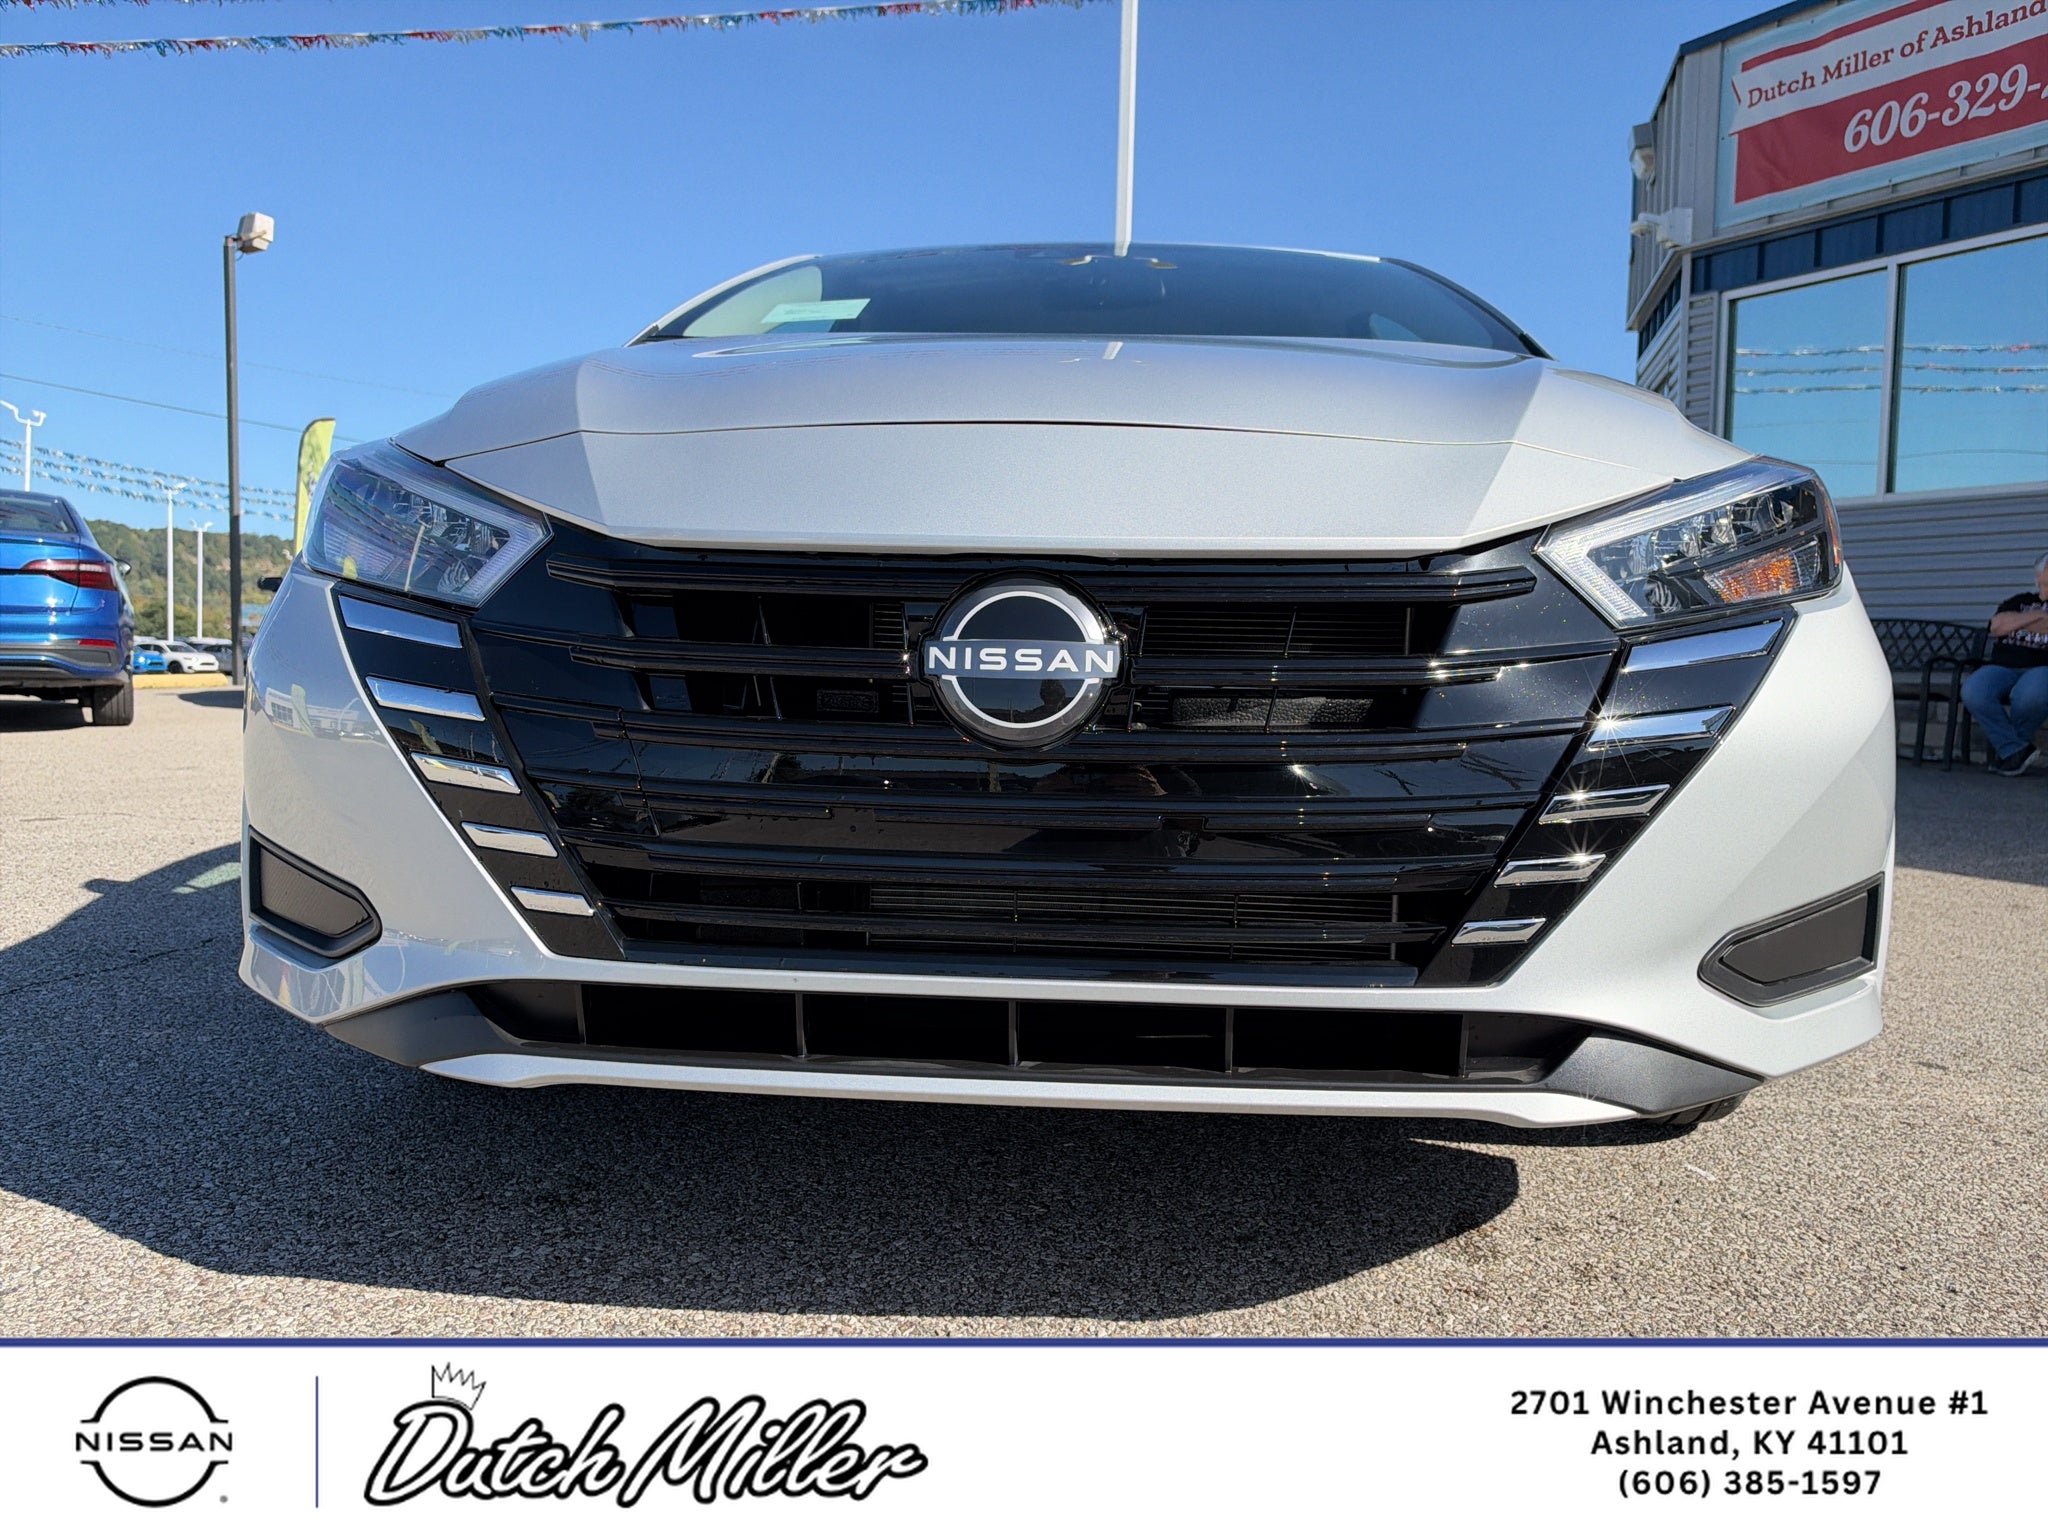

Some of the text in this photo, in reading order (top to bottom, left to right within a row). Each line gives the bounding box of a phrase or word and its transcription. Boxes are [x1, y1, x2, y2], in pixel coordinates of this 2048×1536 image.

[1747, 0, 2047, 108] Dutch Miller of Ashland
[1843, 63, 2048, 153] 606-329-
[928, 646, 1114, 673] NISSAN
